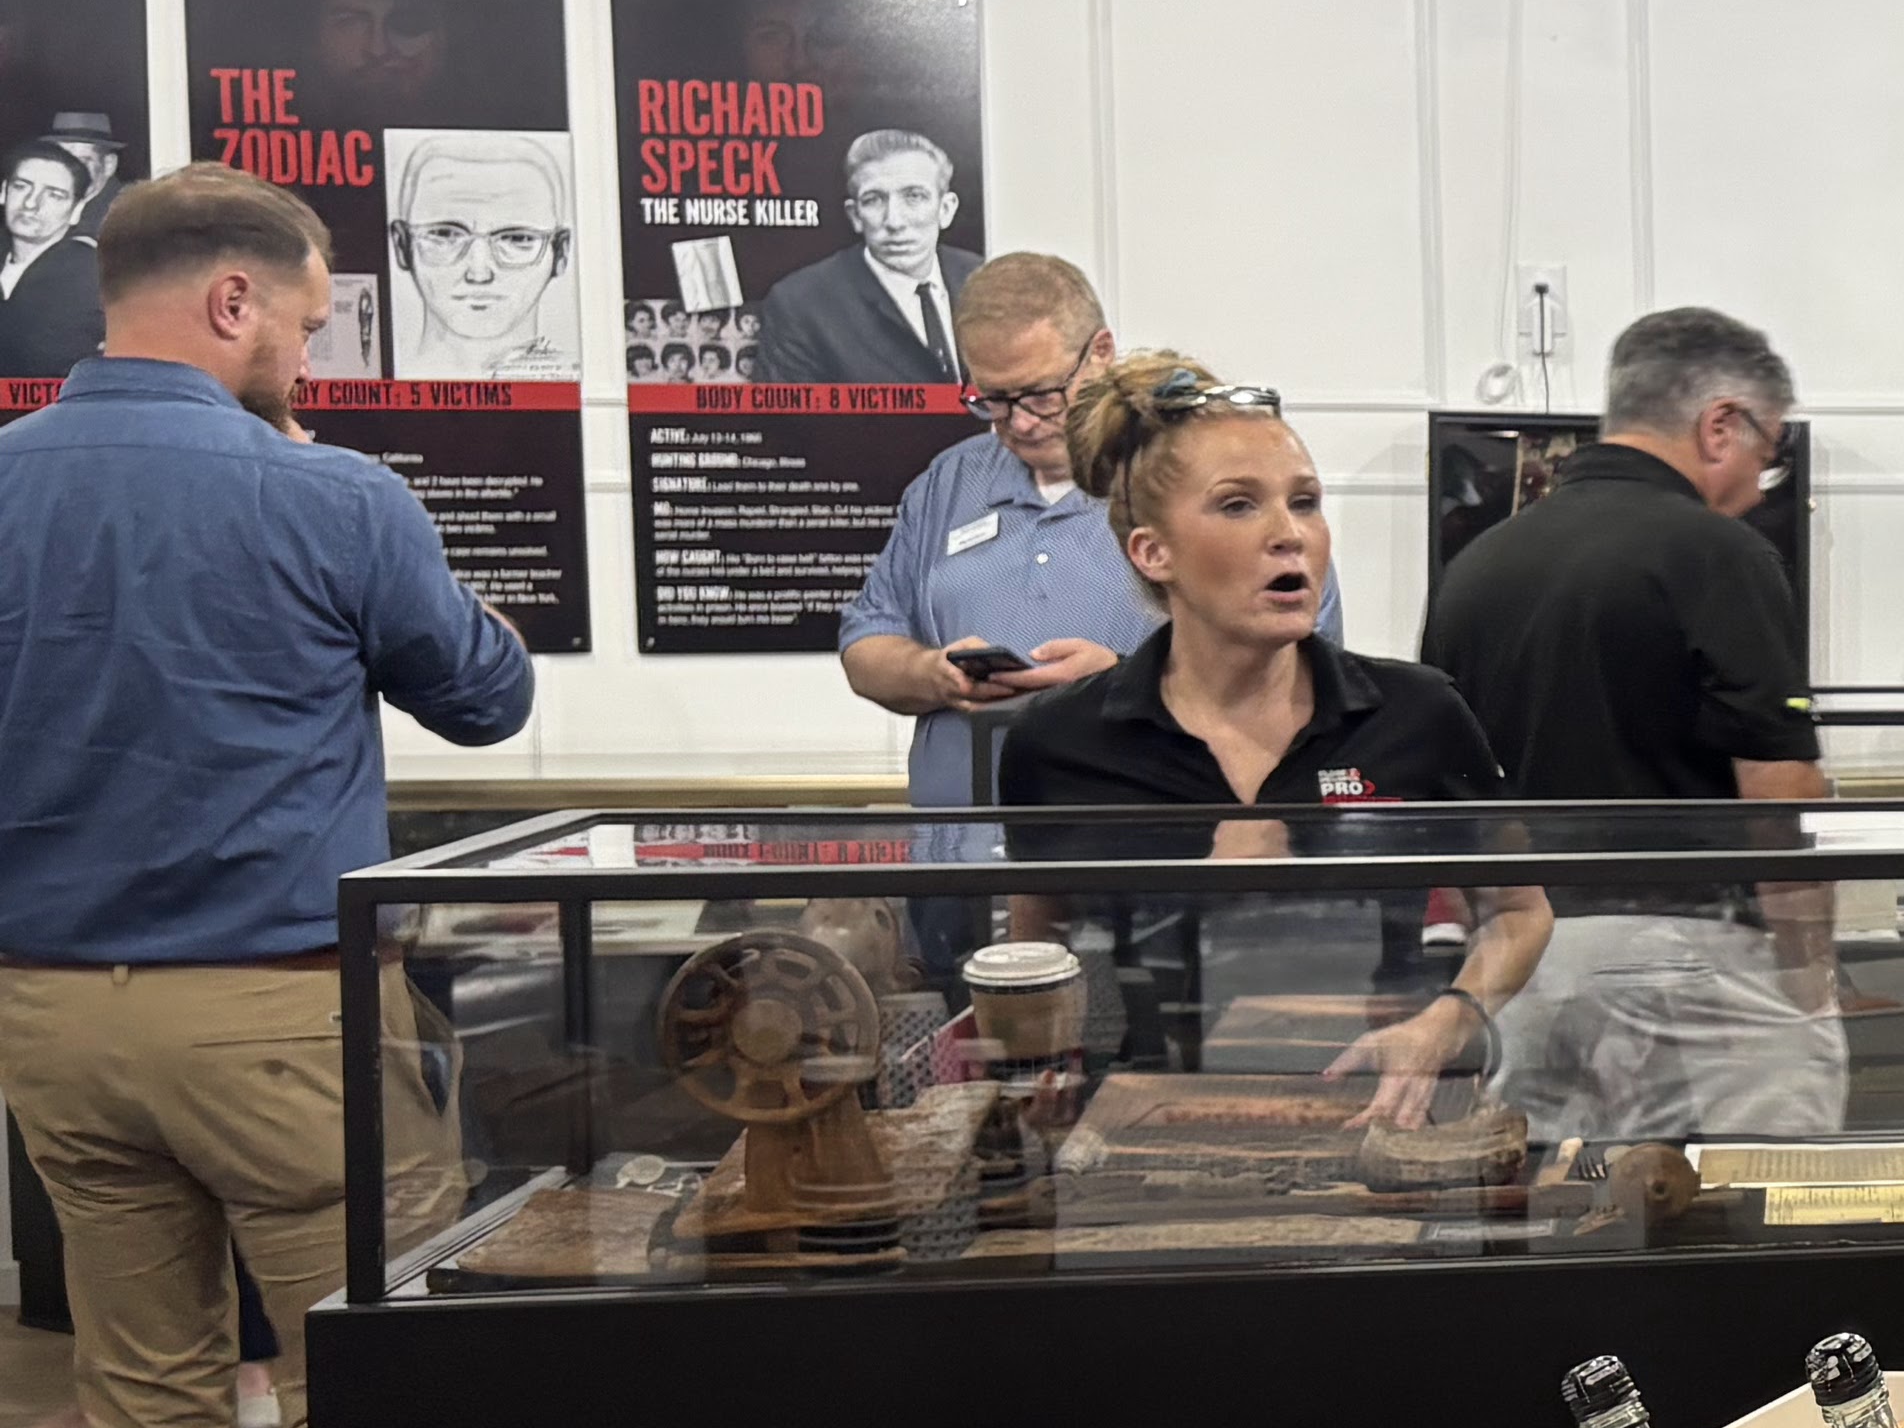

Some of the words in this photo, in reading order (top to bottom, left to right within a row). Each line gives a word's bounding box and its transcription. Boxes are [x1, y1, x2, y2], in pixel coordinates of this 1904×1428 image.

[210, 68, 298, 124] THE
[637, 79, 824, 137] RICHARD
[214, 130, 374, 187] ZODIAC
[640, 139, 782, 195] SPECK
[640, 198, 679, 225] THE
[686, 199, 748, 226] NURSE
[755, 199, 820, 227] KILLER
[411, 384, 421, 406] 5
[430, 383, 512, 406] VICTIMS
[696, 386, 744, 410] BODY
[752, 386, 820, 410] COUNT:
[829, 387, 840, 410] 8
[848, 387, 927, 410] VICTIMS
[1320, 781, 1363, 796] PRO
